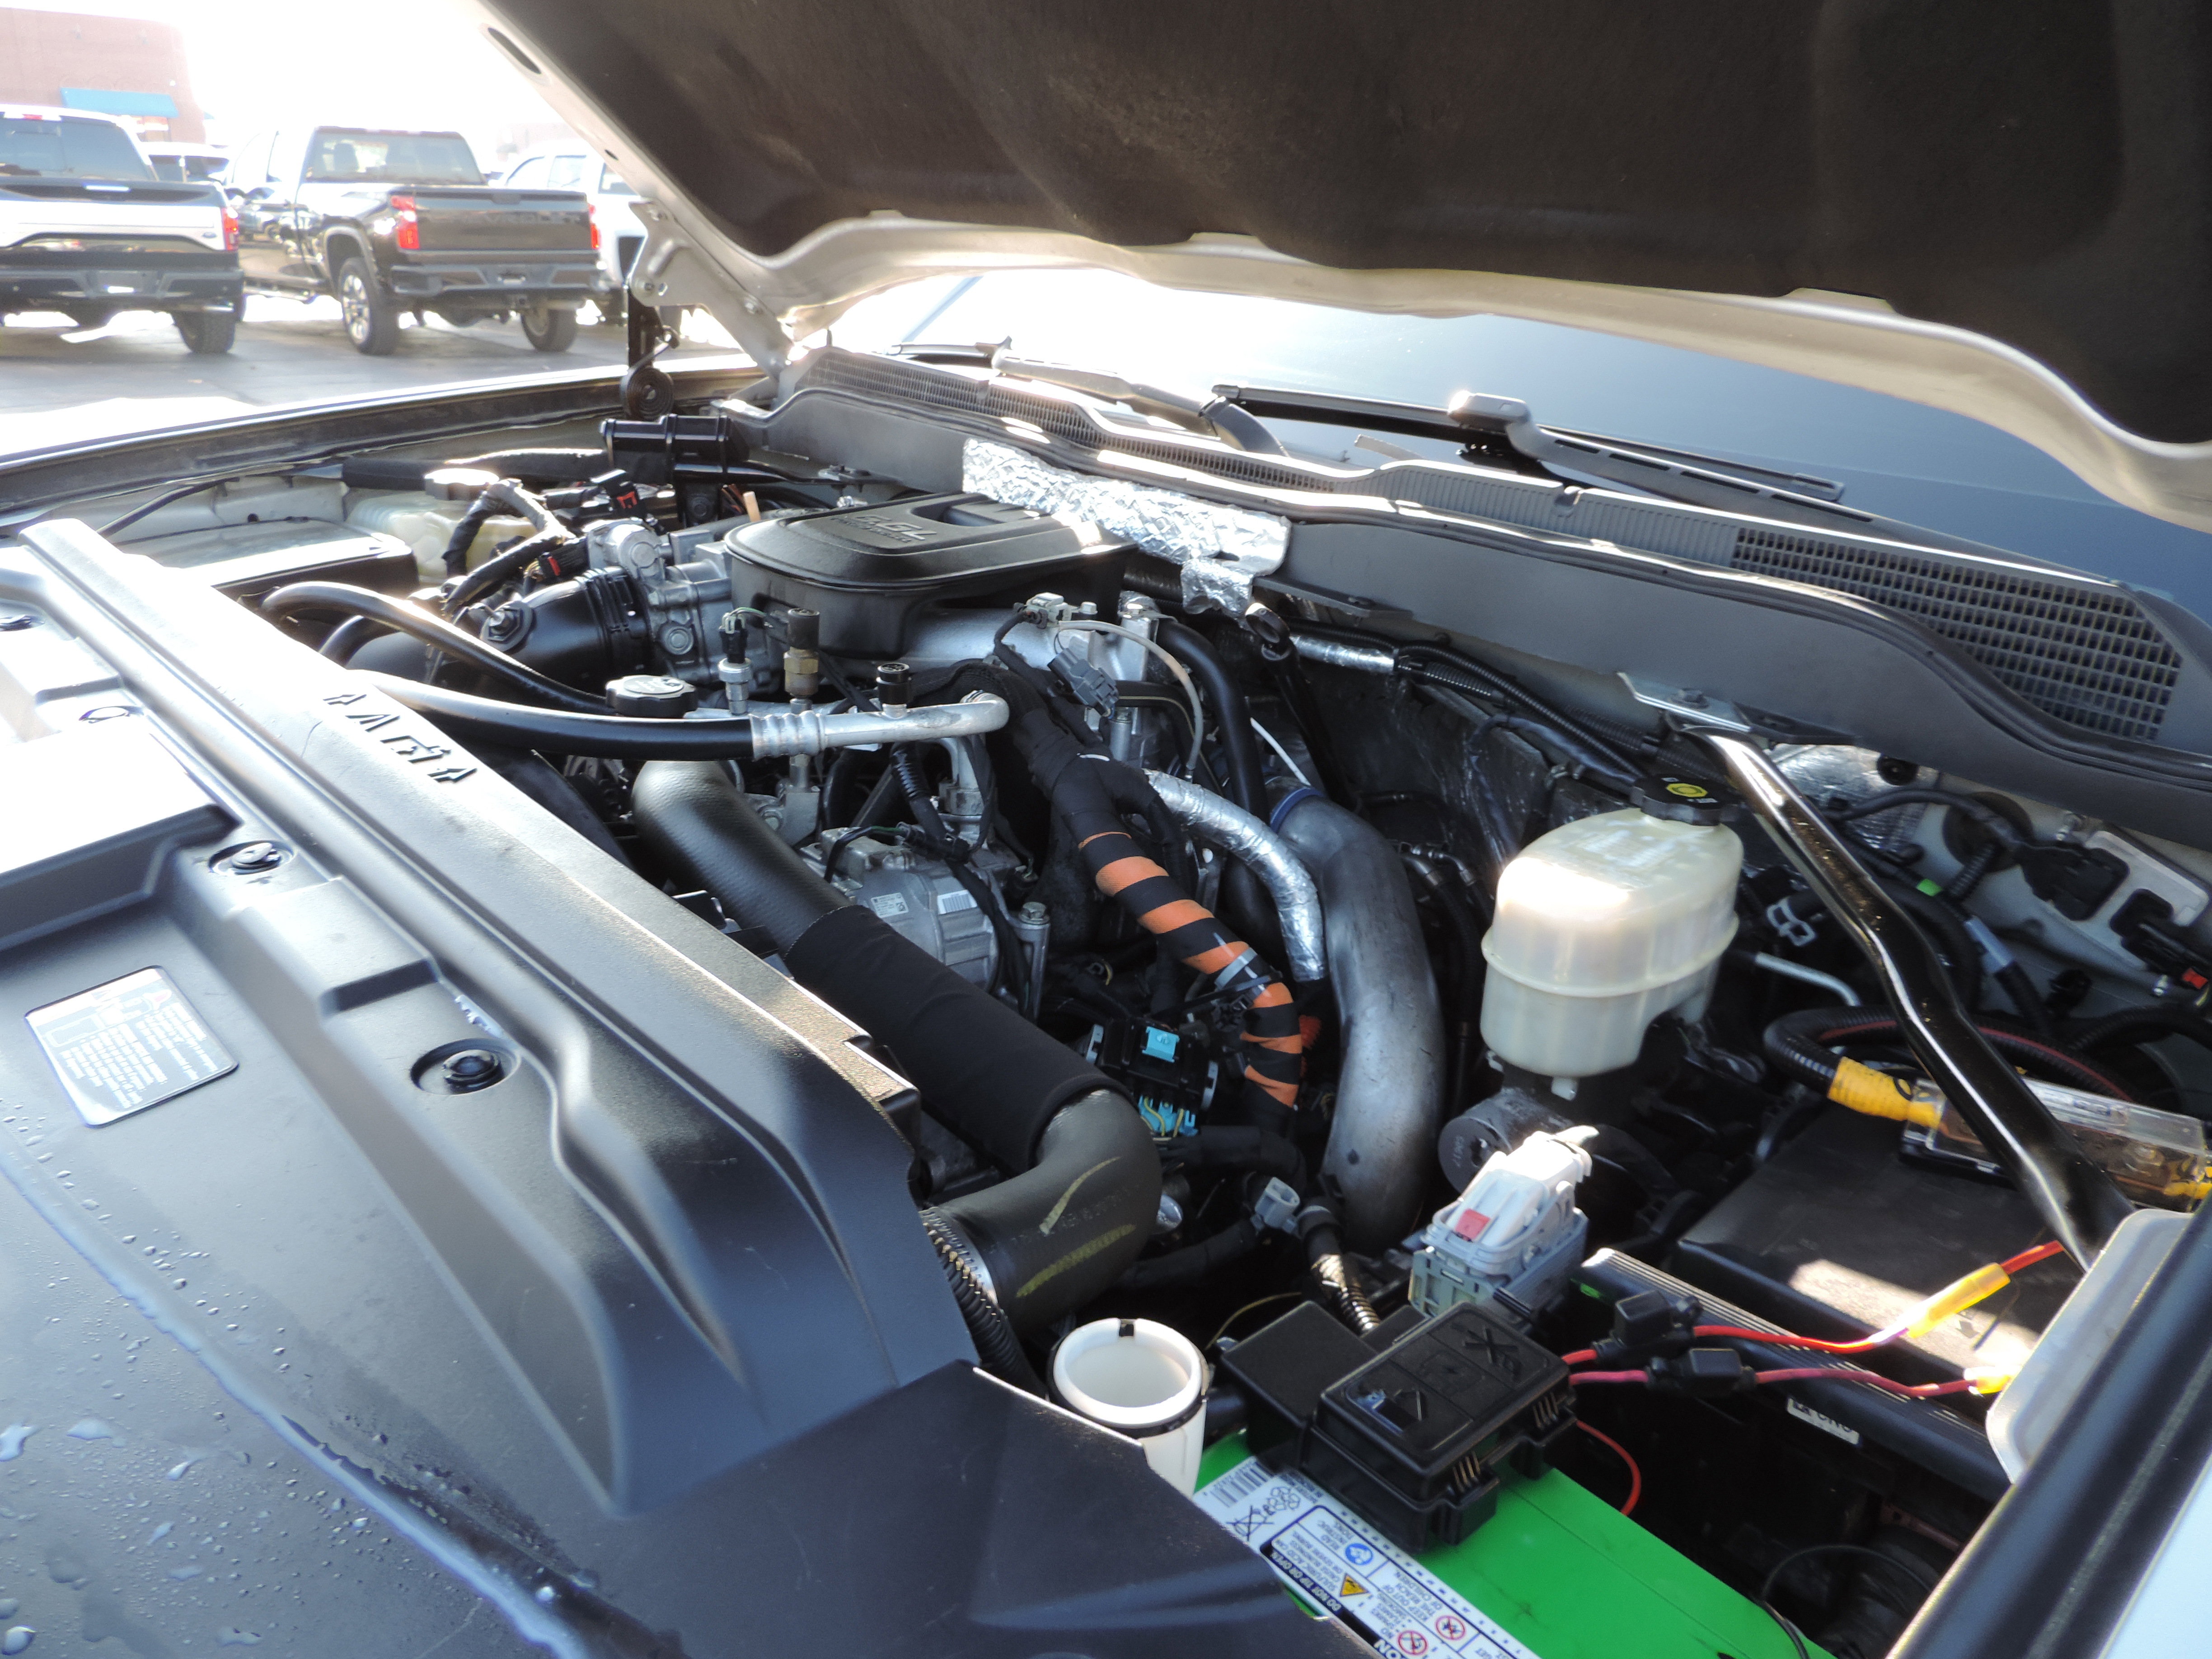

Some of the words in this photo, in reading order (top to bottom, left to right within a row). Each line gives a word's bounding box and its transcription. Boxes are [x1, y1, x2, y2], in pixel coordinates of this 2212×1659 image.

[431, 210, 581, 225] VROLET
[1320, 1534, 1341, 1550] READ
[1286, 1550, 1305, 1564] ACID
[1287, 1566, 1304, 1579] OR
[1302, 1563, 1338, 1591] SULFURIC
[1319, 1566, 1340, 1582] CAUSE
[1298, 1576, 1315, 1588] TIP
[1382, 1584, 1396, 1594] OF
[1310, 1586, 1331, 1601] NOT
[1392, 1592, 1411, 1606] OUT
[1394, 1583, 1422, 1604] REACH
[1325, 1599, 1342, 1611] DO
[1419, 1603, 1436, 1616] THE
[1429, 1600, 1443, 1610] OF
[1369, 1608, 1396, 1629] SPARKS
[1375, 1603, 1402, 1624] FLAMES
[1407, 1605, 1429, 1621] KEEP
[1379, 1627, 1395, 1639] NO
